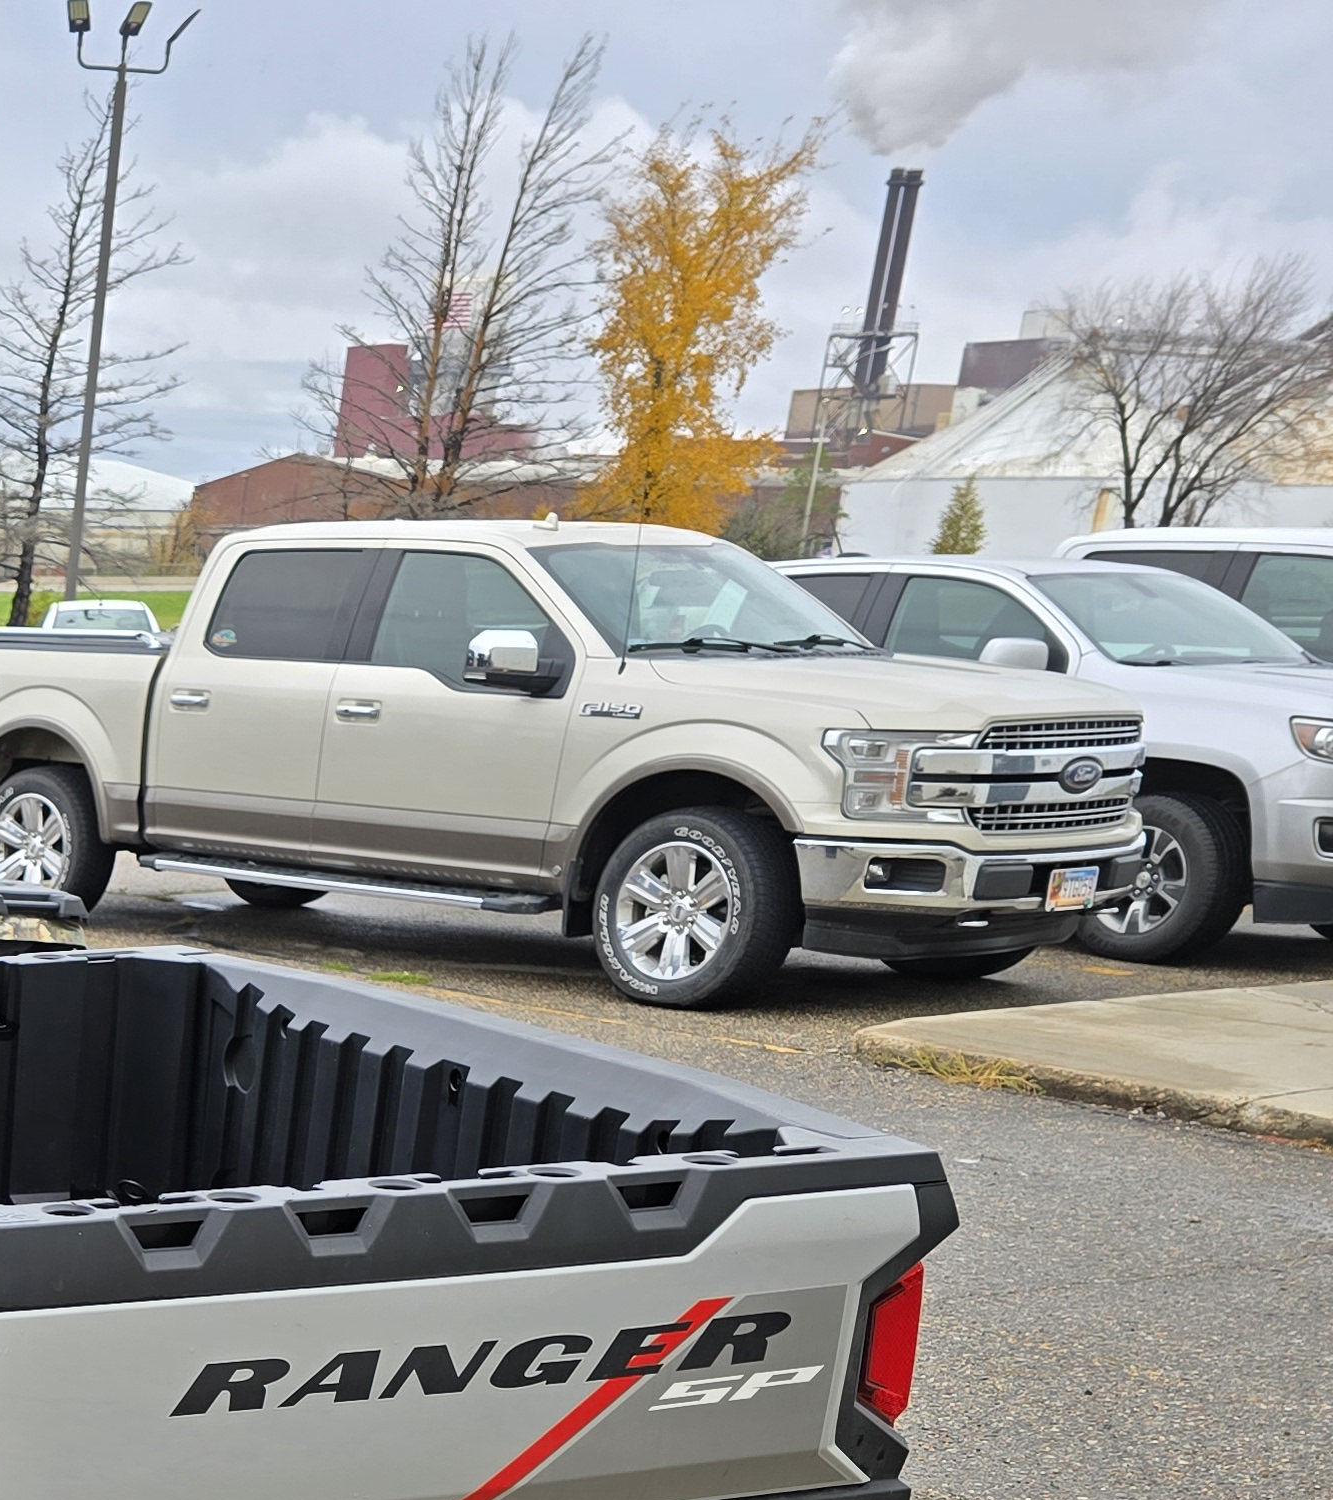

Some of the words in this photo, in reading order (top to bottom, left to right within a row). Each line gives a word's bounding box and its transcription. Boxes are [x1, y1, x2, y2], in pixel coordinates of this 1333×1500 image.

[1073, 765, 1098, 783] Ford
[674, 827, 741, 935] GOODYEAR
[169, 1312, 791, 1418] RANGER
[648, 1365, 824, 1411] SP
